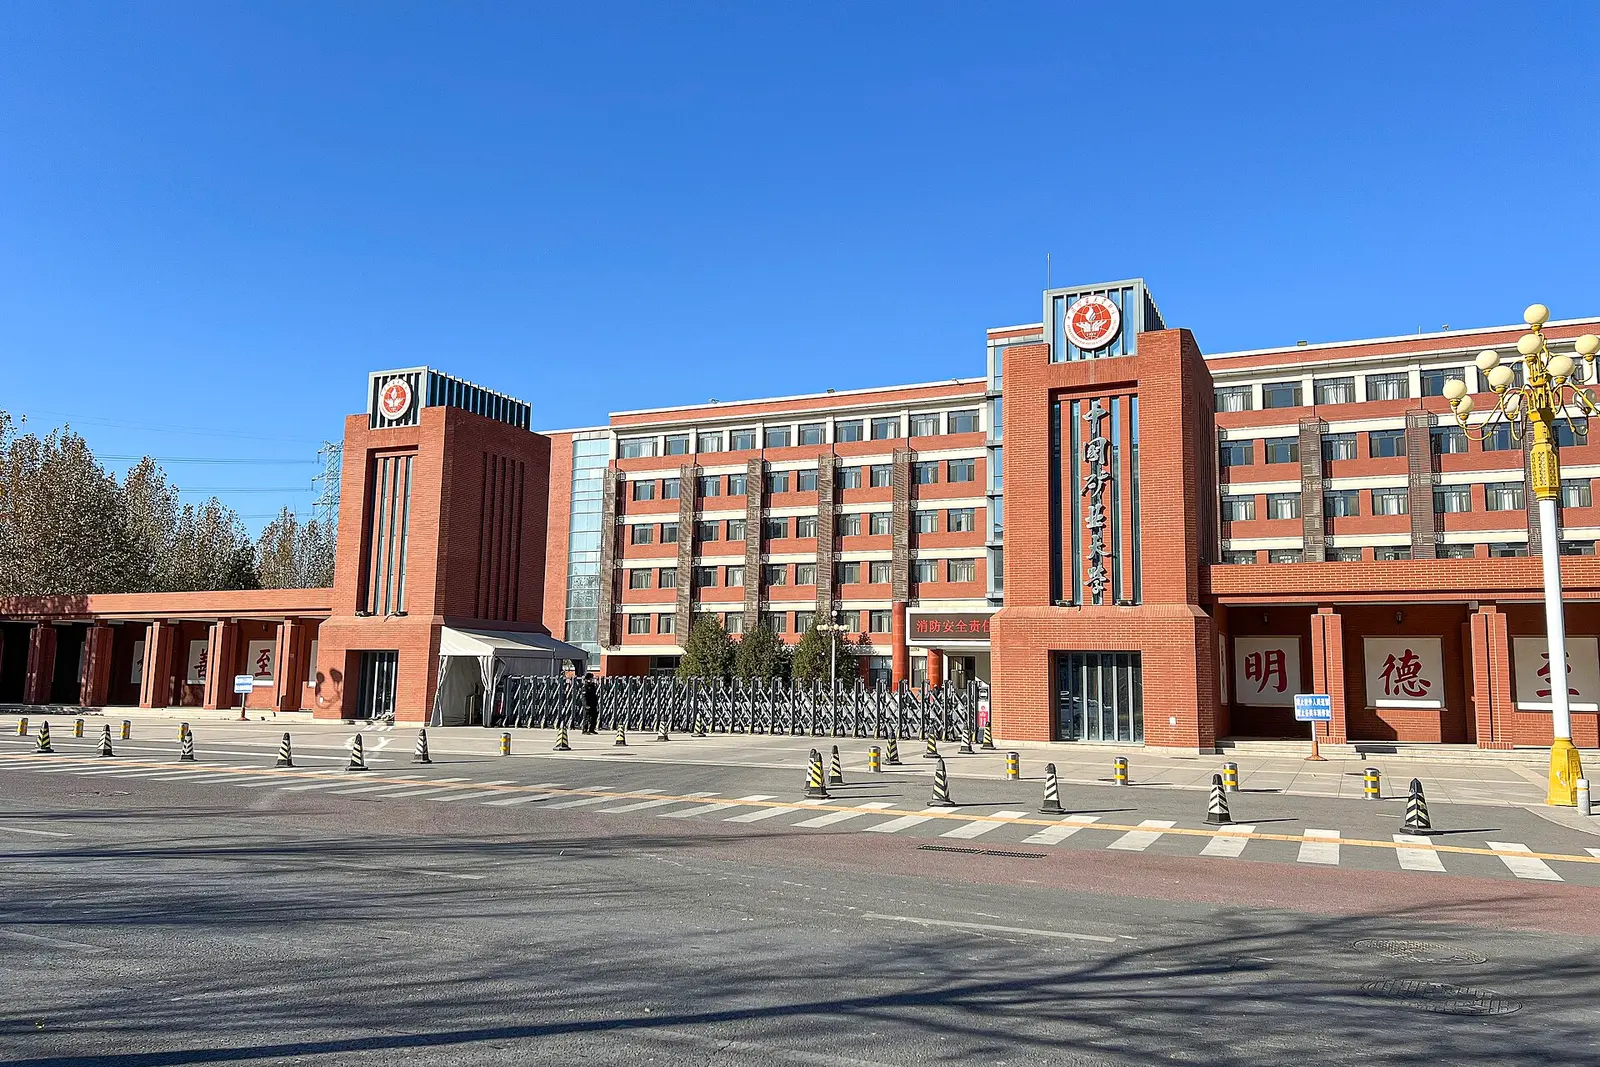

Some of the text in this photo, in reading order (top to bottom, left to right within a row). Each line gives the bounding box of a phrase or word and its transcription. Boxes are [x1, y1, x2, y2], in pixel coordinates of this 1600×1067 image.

[916, 619, 990, 633] 消防安全责任
[255, 648, 272, 677] 至
[1244, 649, 1288, 694] 明
[1377, 648, 1432, 698] 德
